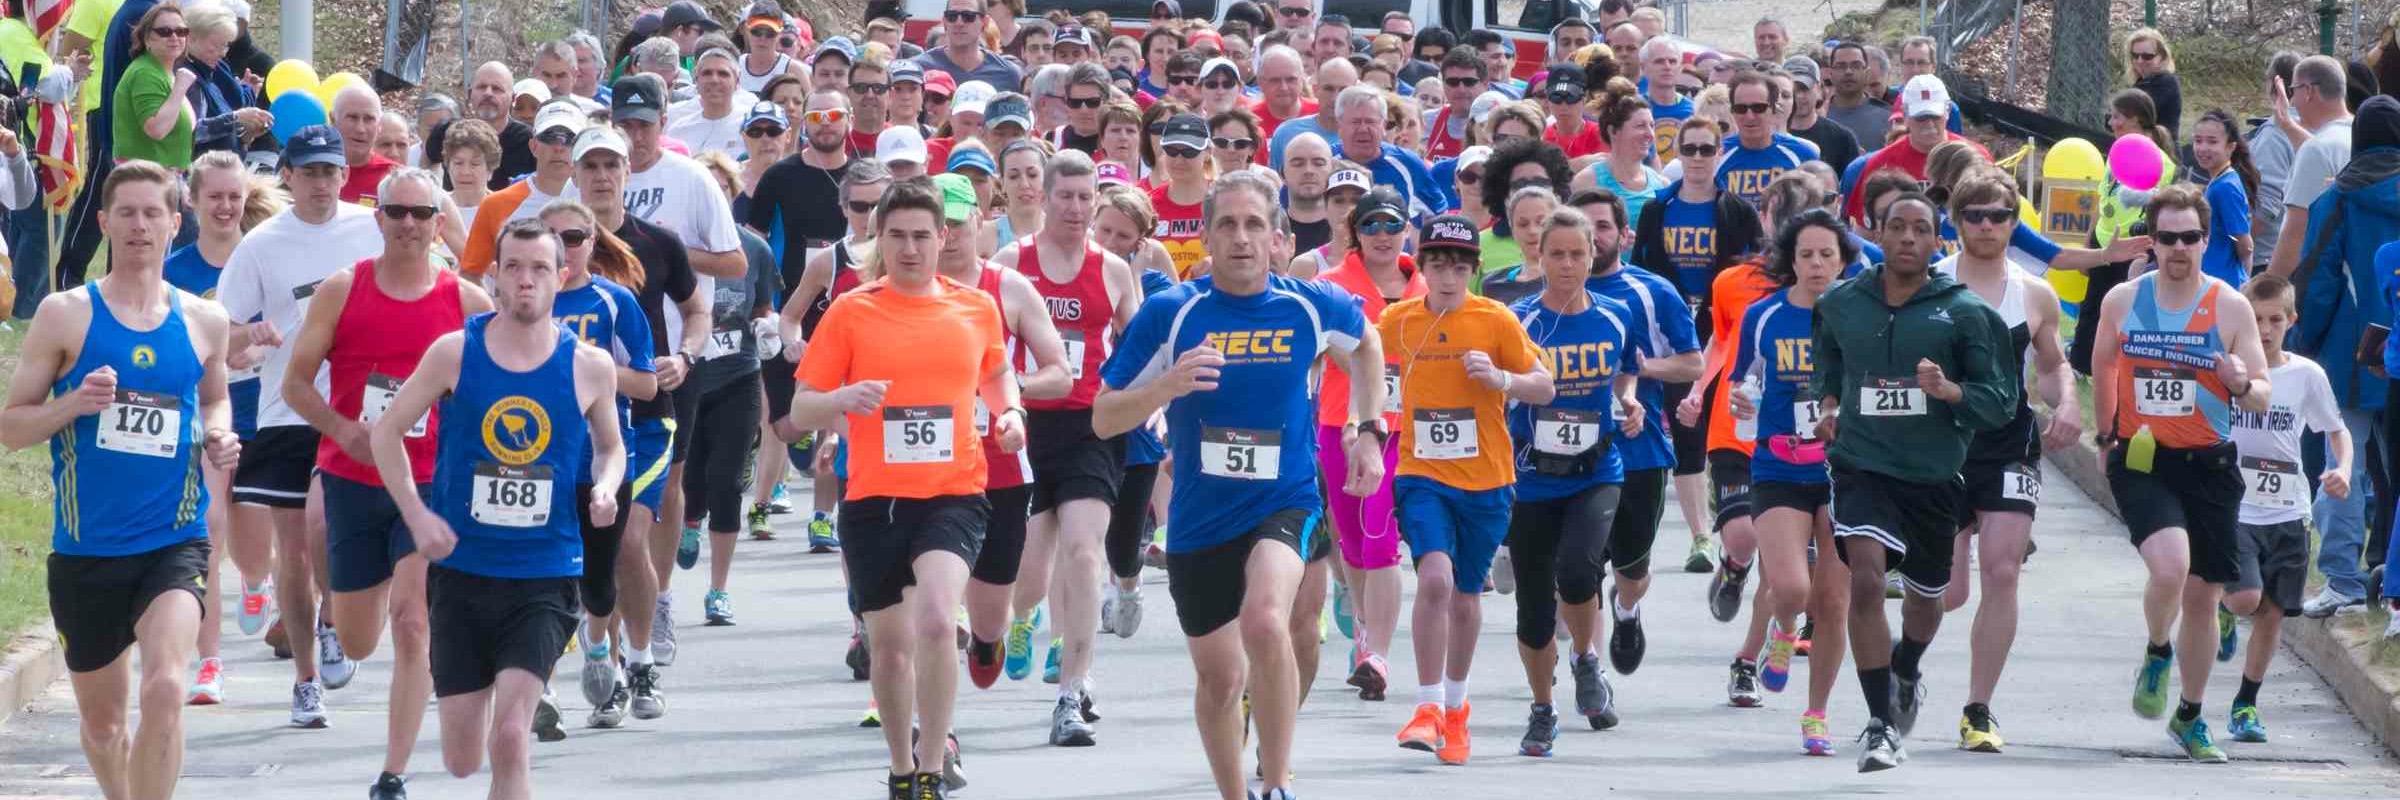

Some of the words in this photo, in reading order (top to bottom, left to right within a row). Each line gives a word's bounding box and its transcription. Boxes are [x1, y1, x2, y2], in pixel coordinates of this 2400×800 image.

[1337, 171, 1360, 181] USA
[1206, 328, 1294, 355] NECC
[2132, 334, 2205, 346] DANA-FARBER
[1540, 341, 1615, 380] NECC
[2123, 344, 2162, 358] CANCER
[2165, 350, 2216, 369] INSTITUTE
[1875, 389, 1912, 411] 211
[2144, 380, 2184, 401] 148
[115, 405, 164, 436] 170
[2266, 410, 2297, 431] IRISH
[903, 420, 937, 446] 56
[1430, 422, 1460, 444] 69
[1557, 423, 1582, 446] 41
[1225, 445, 1257, 473] 51
[487, 479, 537, 507] 168
[2256, 472, 2281, 494] 79
